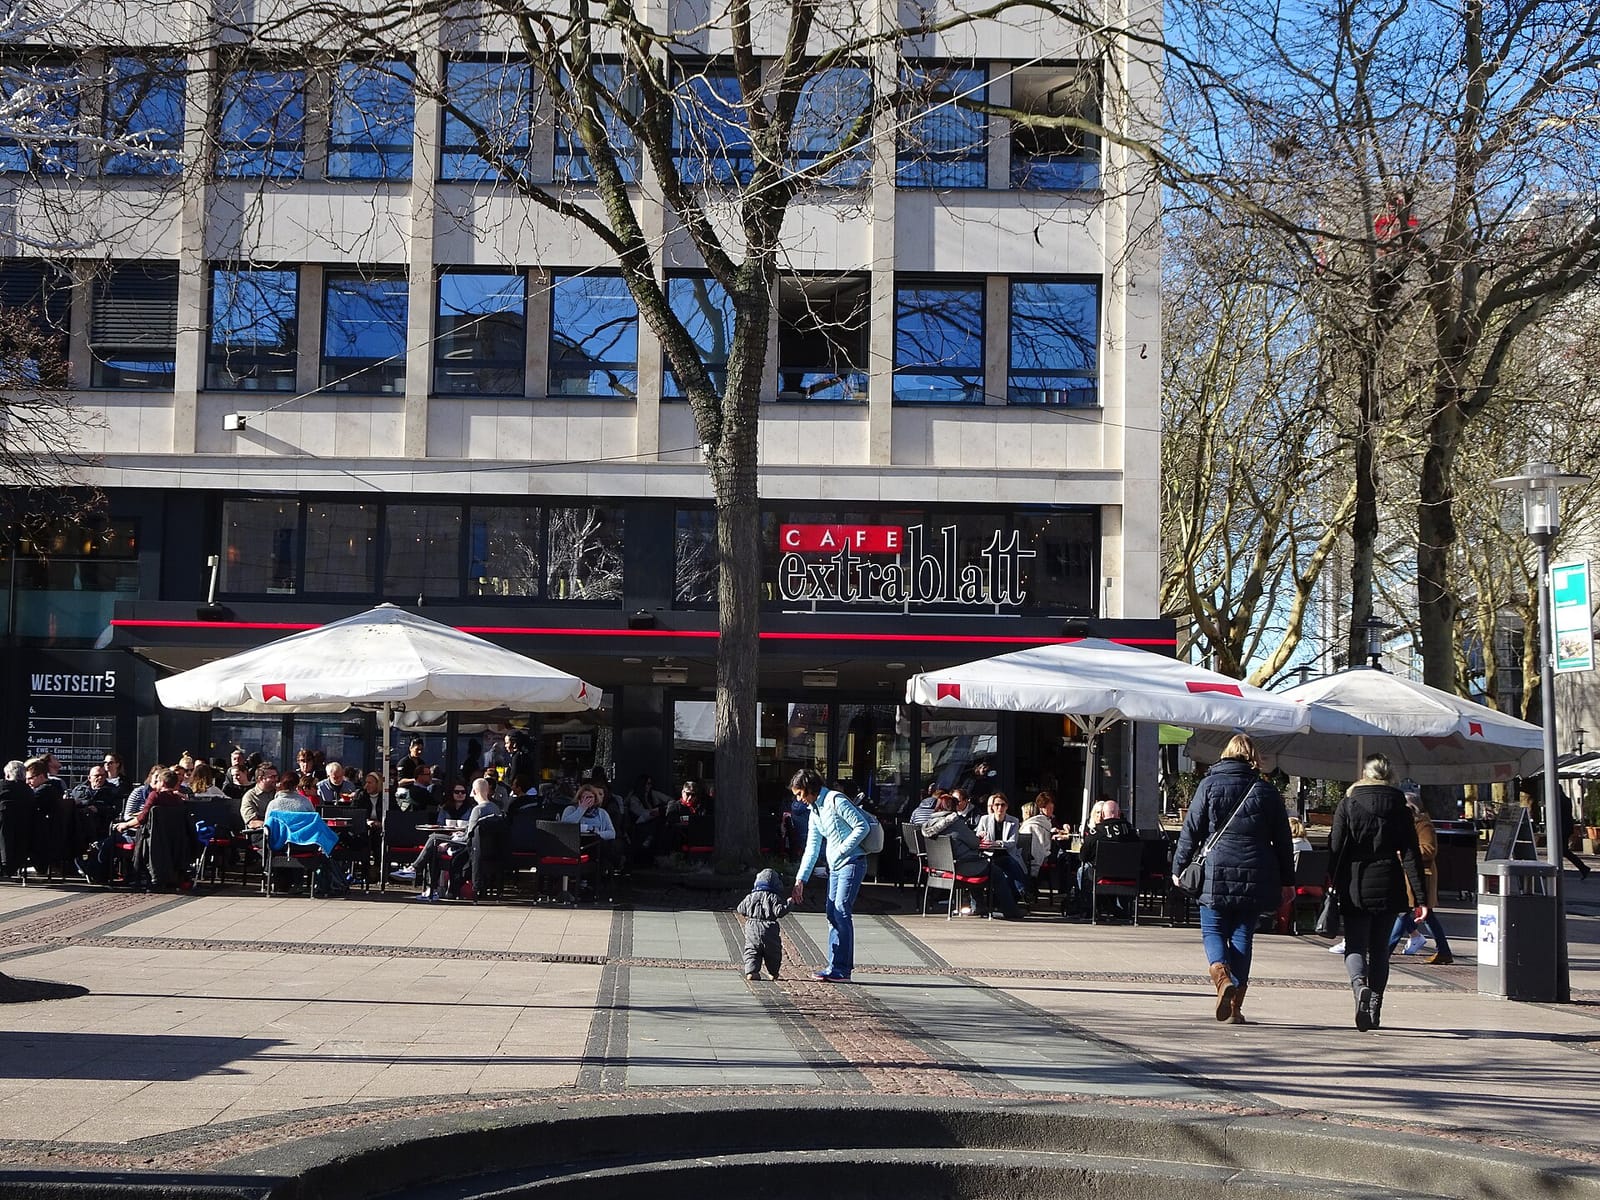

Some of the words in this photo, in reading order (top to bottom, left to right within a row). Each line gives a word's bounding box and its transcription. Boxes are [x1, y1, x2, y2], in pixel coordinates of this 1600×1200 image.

[785, 529, 898, 548] CAFE
[778, 523, 1036, 606] extrablatt
[29, 705, 36, 714] 6.
[28, 721, 35, 729] 5.
[27, 735, 35, 743] 4.
